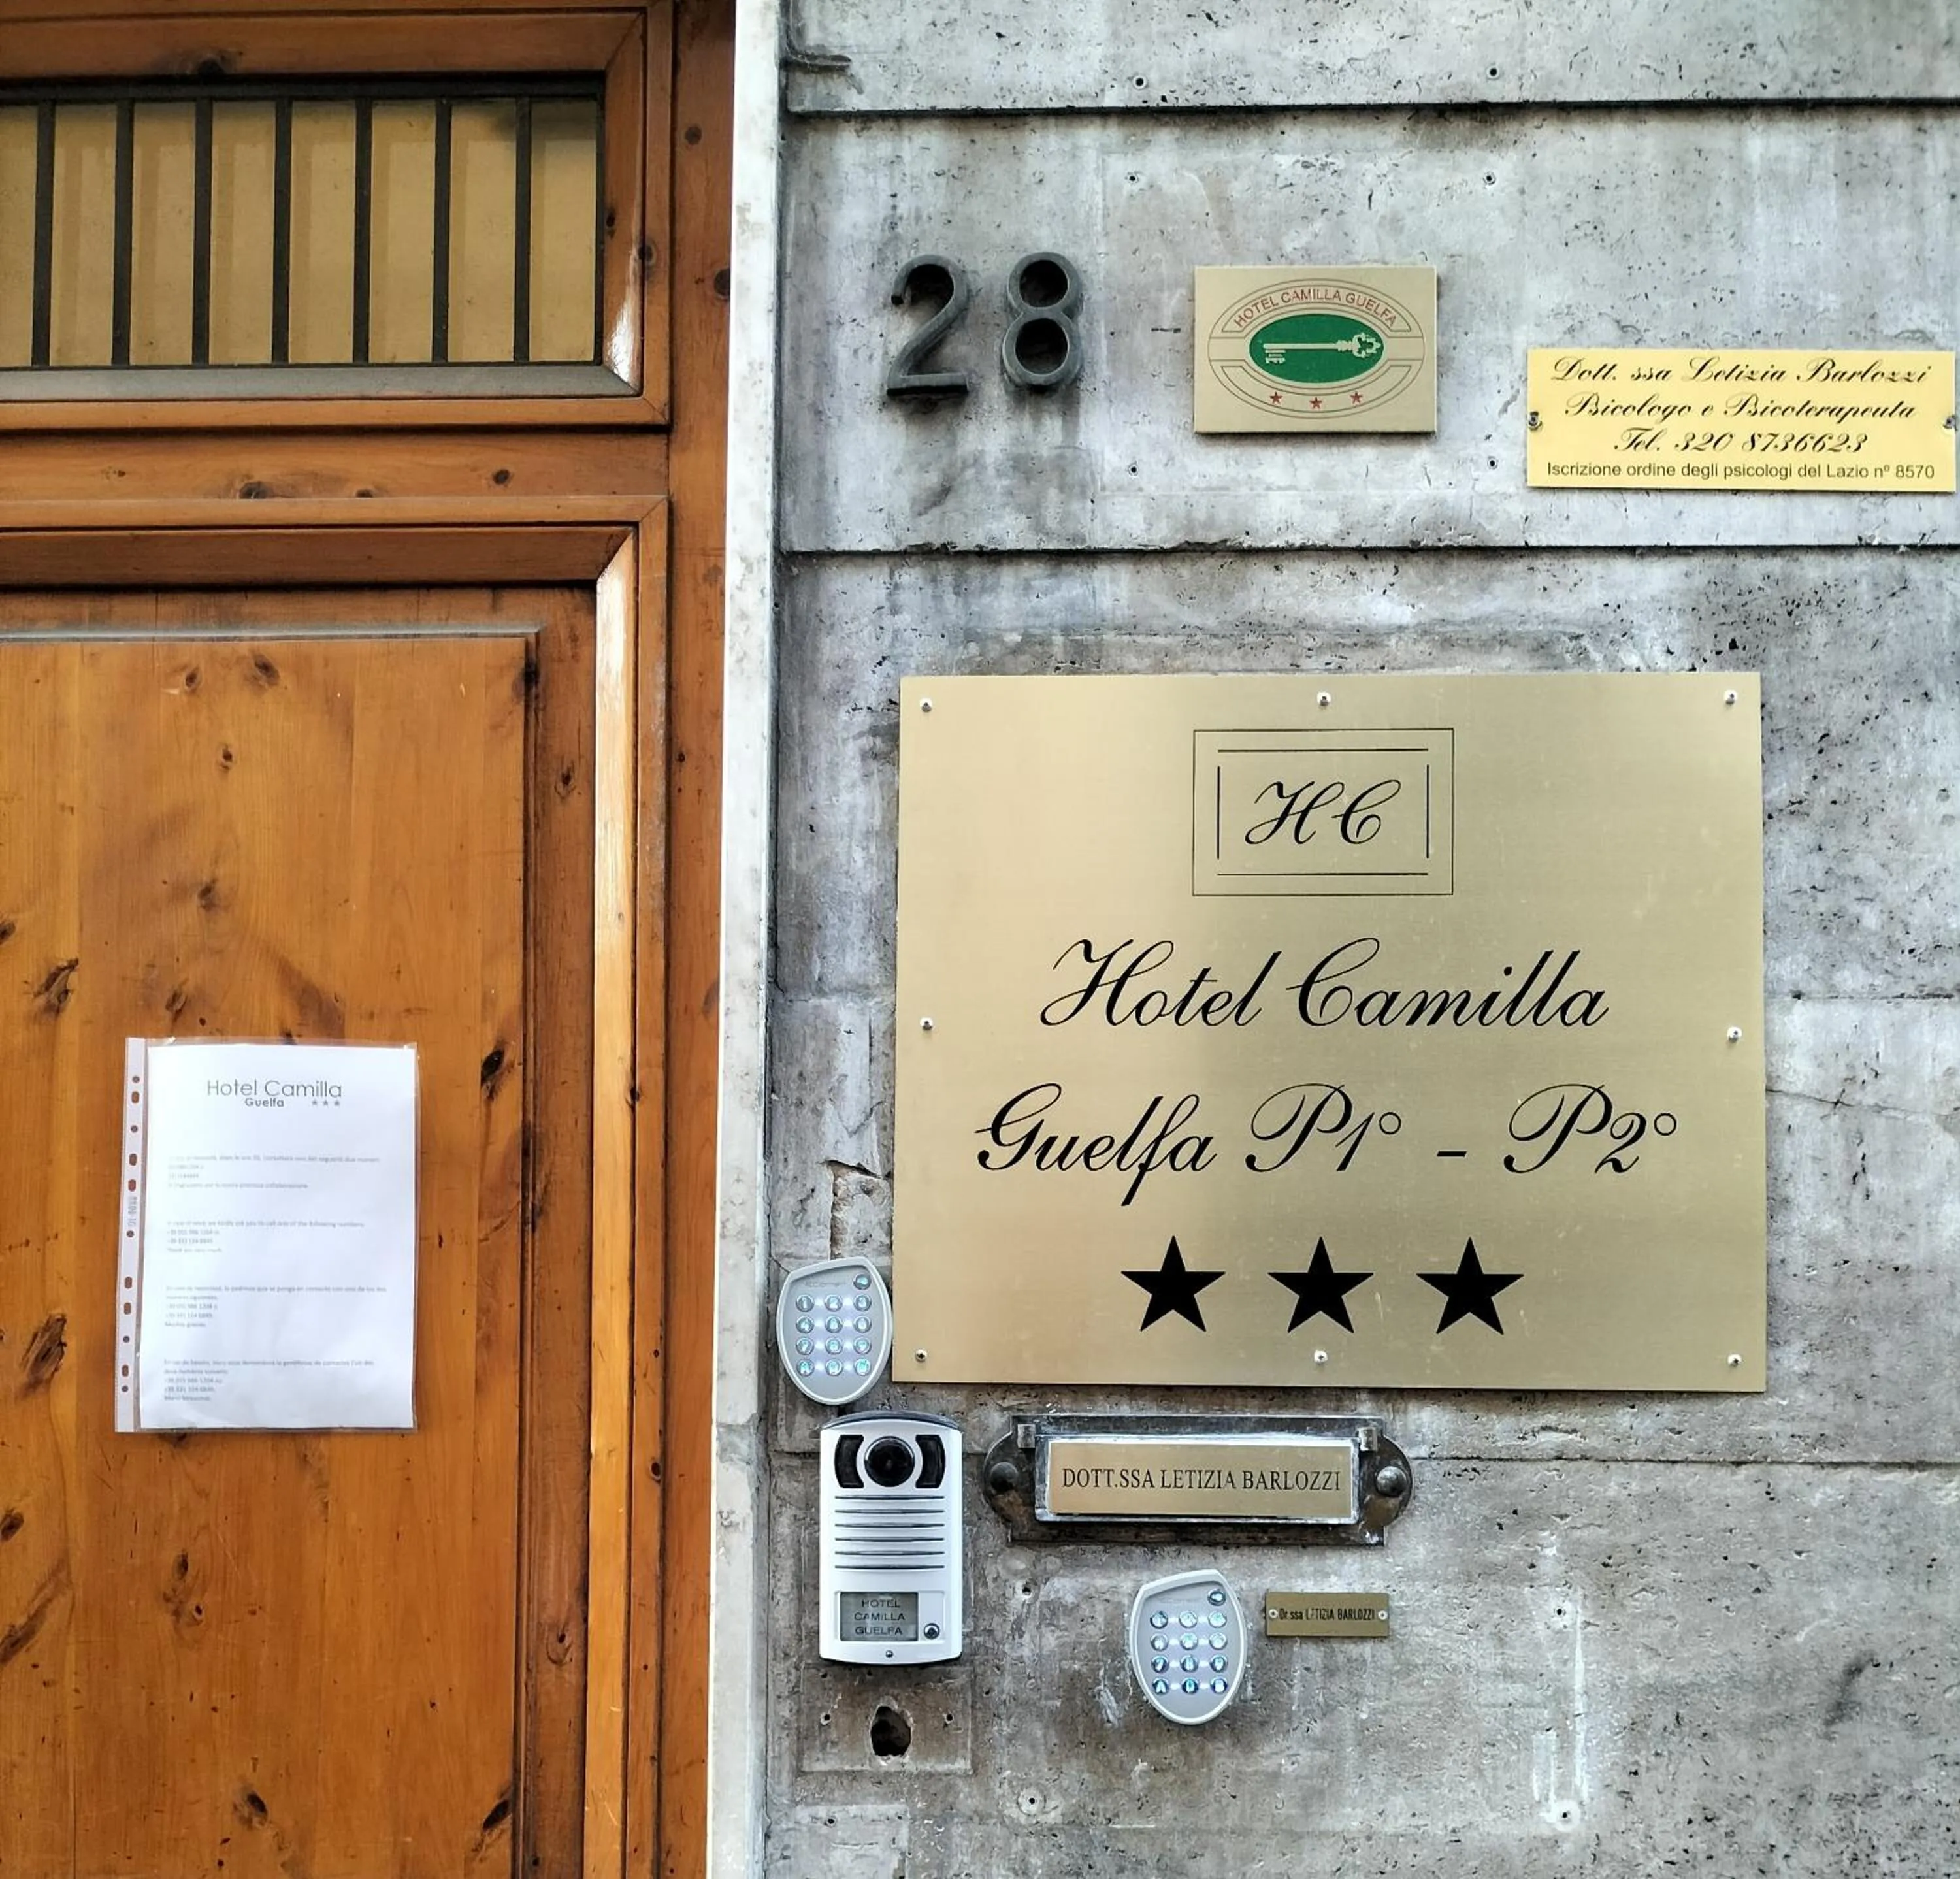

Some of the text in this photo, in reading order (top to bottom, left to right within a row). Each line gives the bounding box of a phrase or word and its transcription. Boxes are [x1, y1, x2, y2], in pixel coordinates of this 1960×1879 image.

[1233, 287, 1398, 327] HOTEL CAMILLA GUELFA
[886, 252, 1083, 396] 28
[1552, 357, 1932, 384] Dott. ssa Letizia Barlozzi
[1564, 393, 1916, 425] Psicologo e Psicoterapeuta
[1614, 427, 1868, 453] Tel. 320 8736623
[1547, 462, 1622, 477] Iscrizione
[1626, 462, 1676, 477] ordine
[1681, 463, 1718, 480] degli
[1723, 463, 1793, 481] psicologi
[1797, 463, 1821, 478] del
[1827, 463, 1869, 478] Lazio
[1895, 464, 1935, 479] 8570
[1039, 937, 1610, 1028] Hotel Camilla
[206, 1078, 342, 1098] Hotel Camilla
[244, 1097, 285, 1108] Guelfa
[973, 1082, 1218, 1207] Guelfa
[1062, 1467, 1341, 1491] DOTT.SSA LETIZIA BARLOZZI
[861, 1599, 901, 1608] HOTEL
[1337, 1608, 1375, 1621] BARLOZZI
[853, 1612, 906, 1621] CAMILLA
[855, 1626, 904, 1635] GUELFA
